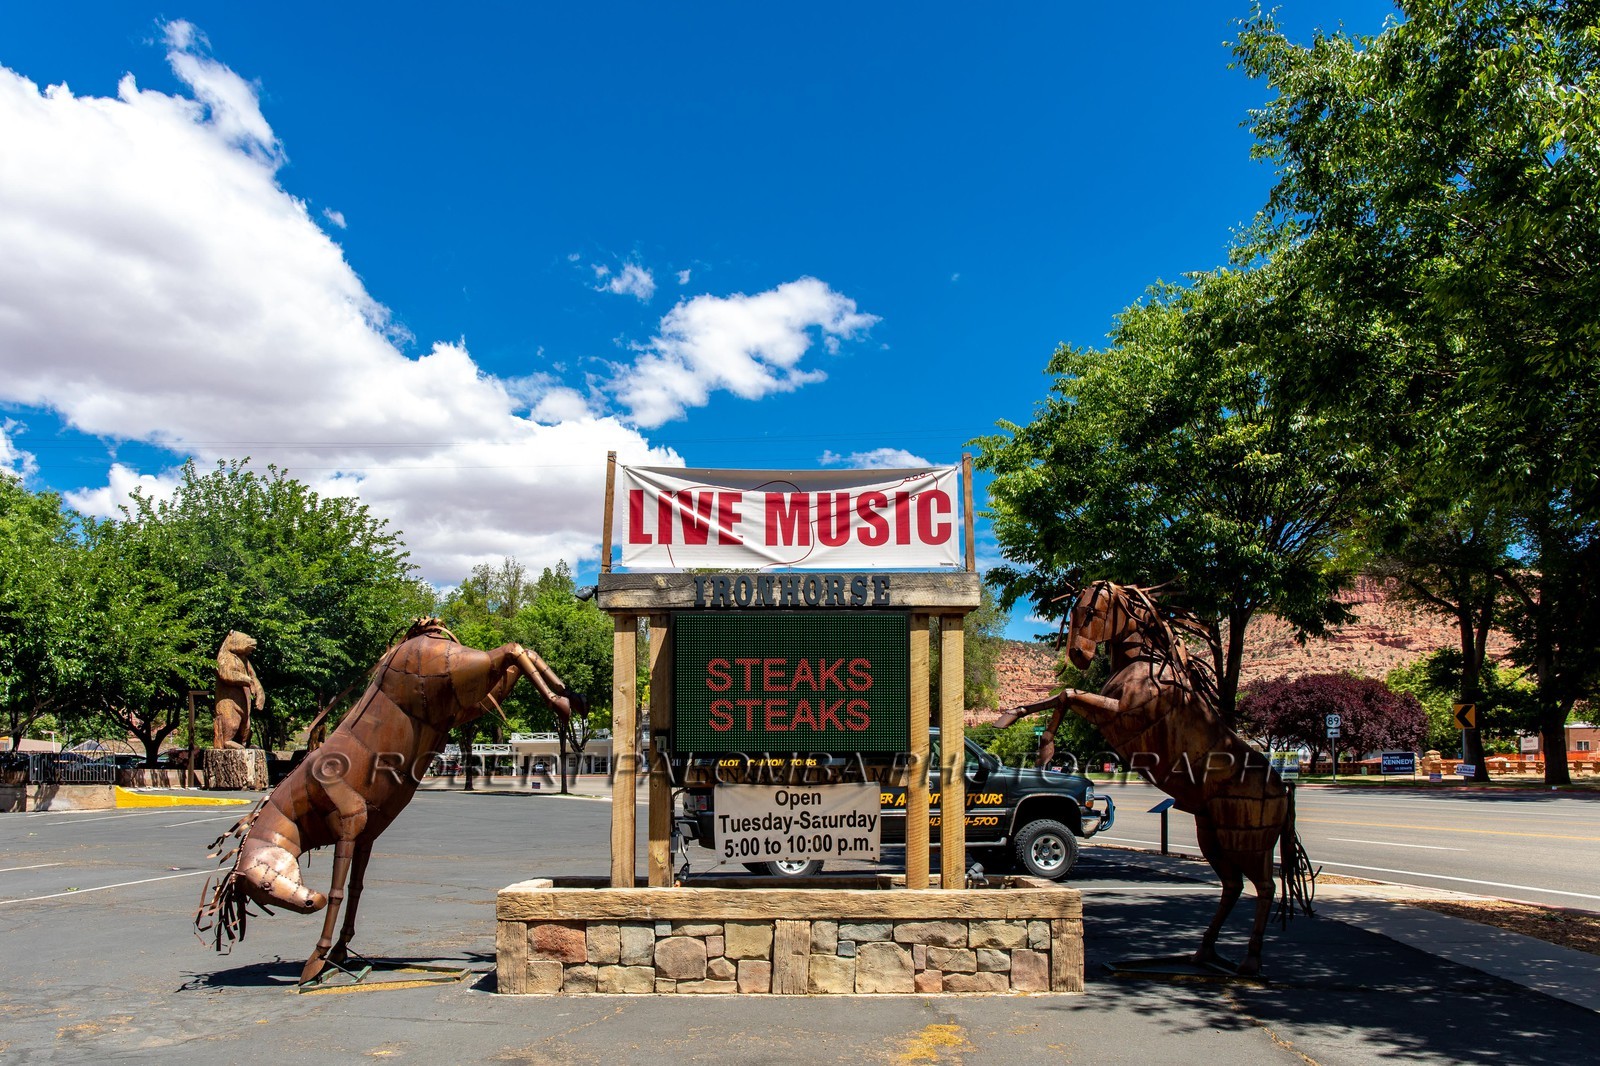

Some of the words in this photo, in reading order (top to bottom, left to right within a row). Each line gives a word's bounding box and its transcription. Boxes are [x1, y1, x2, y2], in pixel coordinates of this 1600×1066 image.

[628, 489, 744, 546] LIVE
[765, 489, 952, 547] MUSIC
[694, 575, 890, 607] IRONHORSE
[706, 658, 873, 691] STEAKS
[709, 698, 871, 731] STEAKS
[1327, 716, 1340, 725] 89
[718, 759, 741, 767] SLOT
[789, 759, 817, 767] TOURS
[1383, 758, 1414, 766] KENNEDY
[775, 790, 822, 810] Open
[966, 793, 1004, 806] TOURS
[718, 810, 878, 835] Tuesday-Saturday
[724, 837, 760, 858] 5:00
[765, 837, 782, 855] to
[787, 834, 832, 854] 10:00
[838, 836, 874, 856] p.m.
